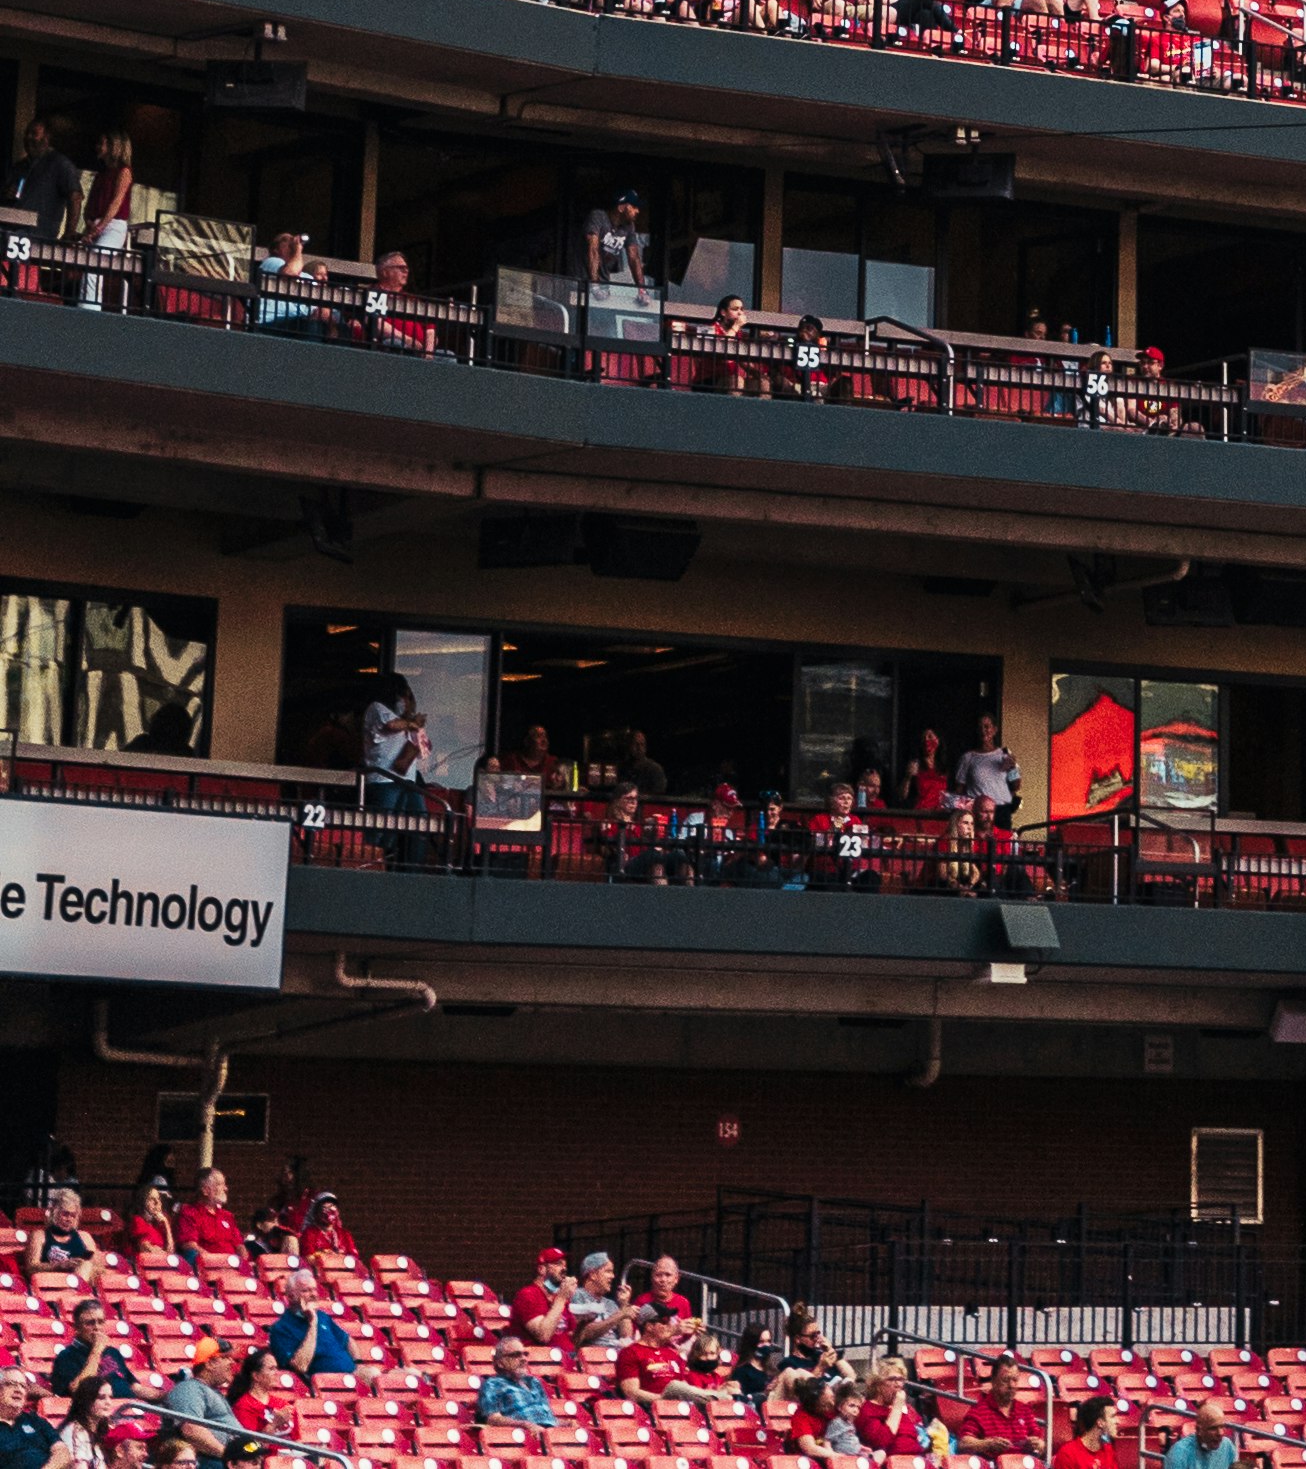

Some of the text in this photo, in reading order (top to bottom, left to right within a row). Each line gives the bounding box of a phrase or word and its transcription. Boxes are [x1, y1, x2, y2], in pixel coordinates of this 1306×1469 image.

[6, 235, 31, 260] 53
[365, 291, 388, 316] 54
[797, 345, 820, 368] 55
[1086, 373, 1109, 396] 56
[302, 804, 327, 829] 22
[839, 835, 862, 858] 23
[36, 872, 274, 947] Technology
[719, 1122, 739, 1139] 154
